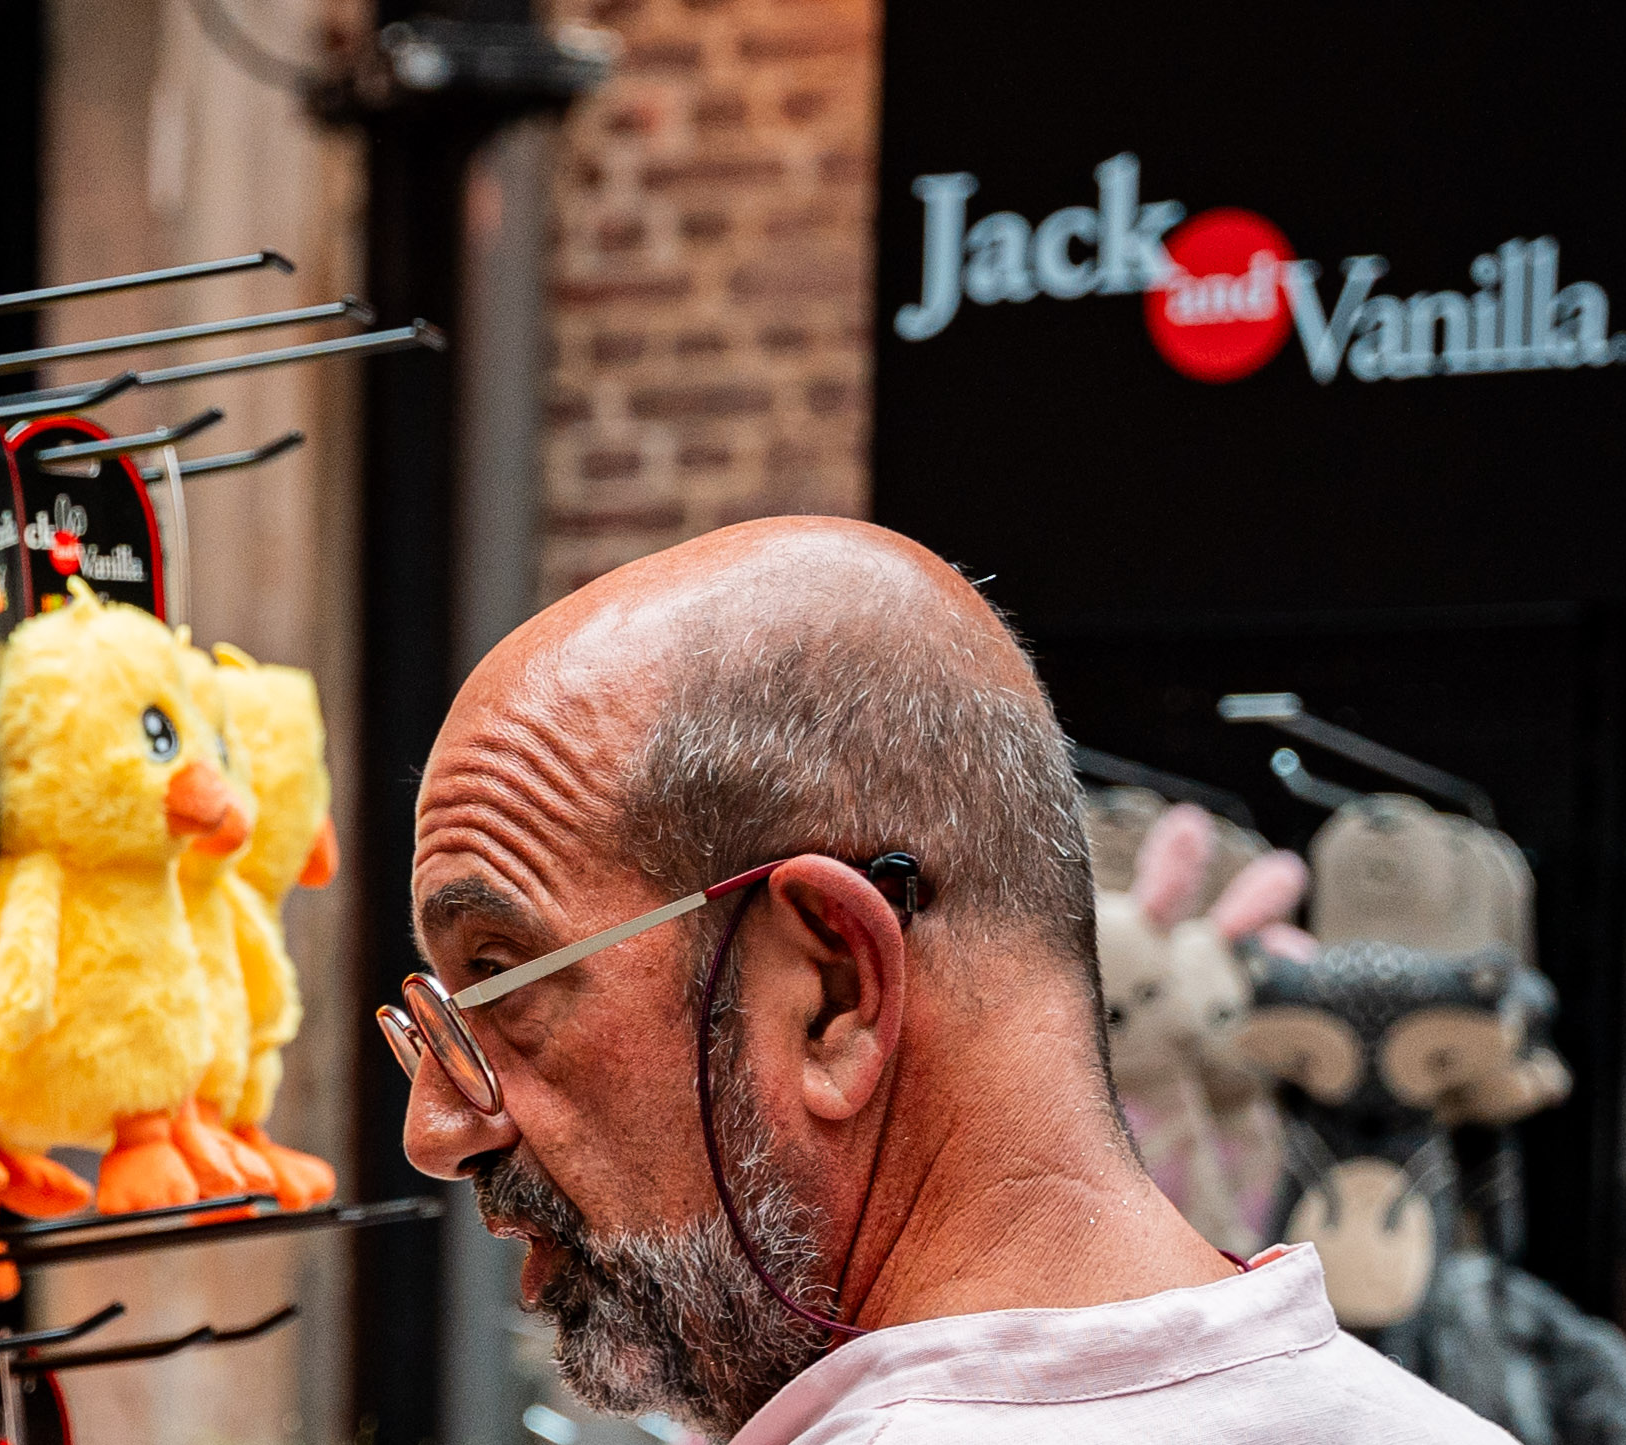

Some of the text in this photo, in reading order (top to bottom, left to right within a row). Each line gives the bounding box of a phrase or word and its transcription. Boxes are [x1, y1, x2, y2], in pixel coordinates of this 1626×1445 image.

[894, 152, 1614, 385] Jack and Vanilla
